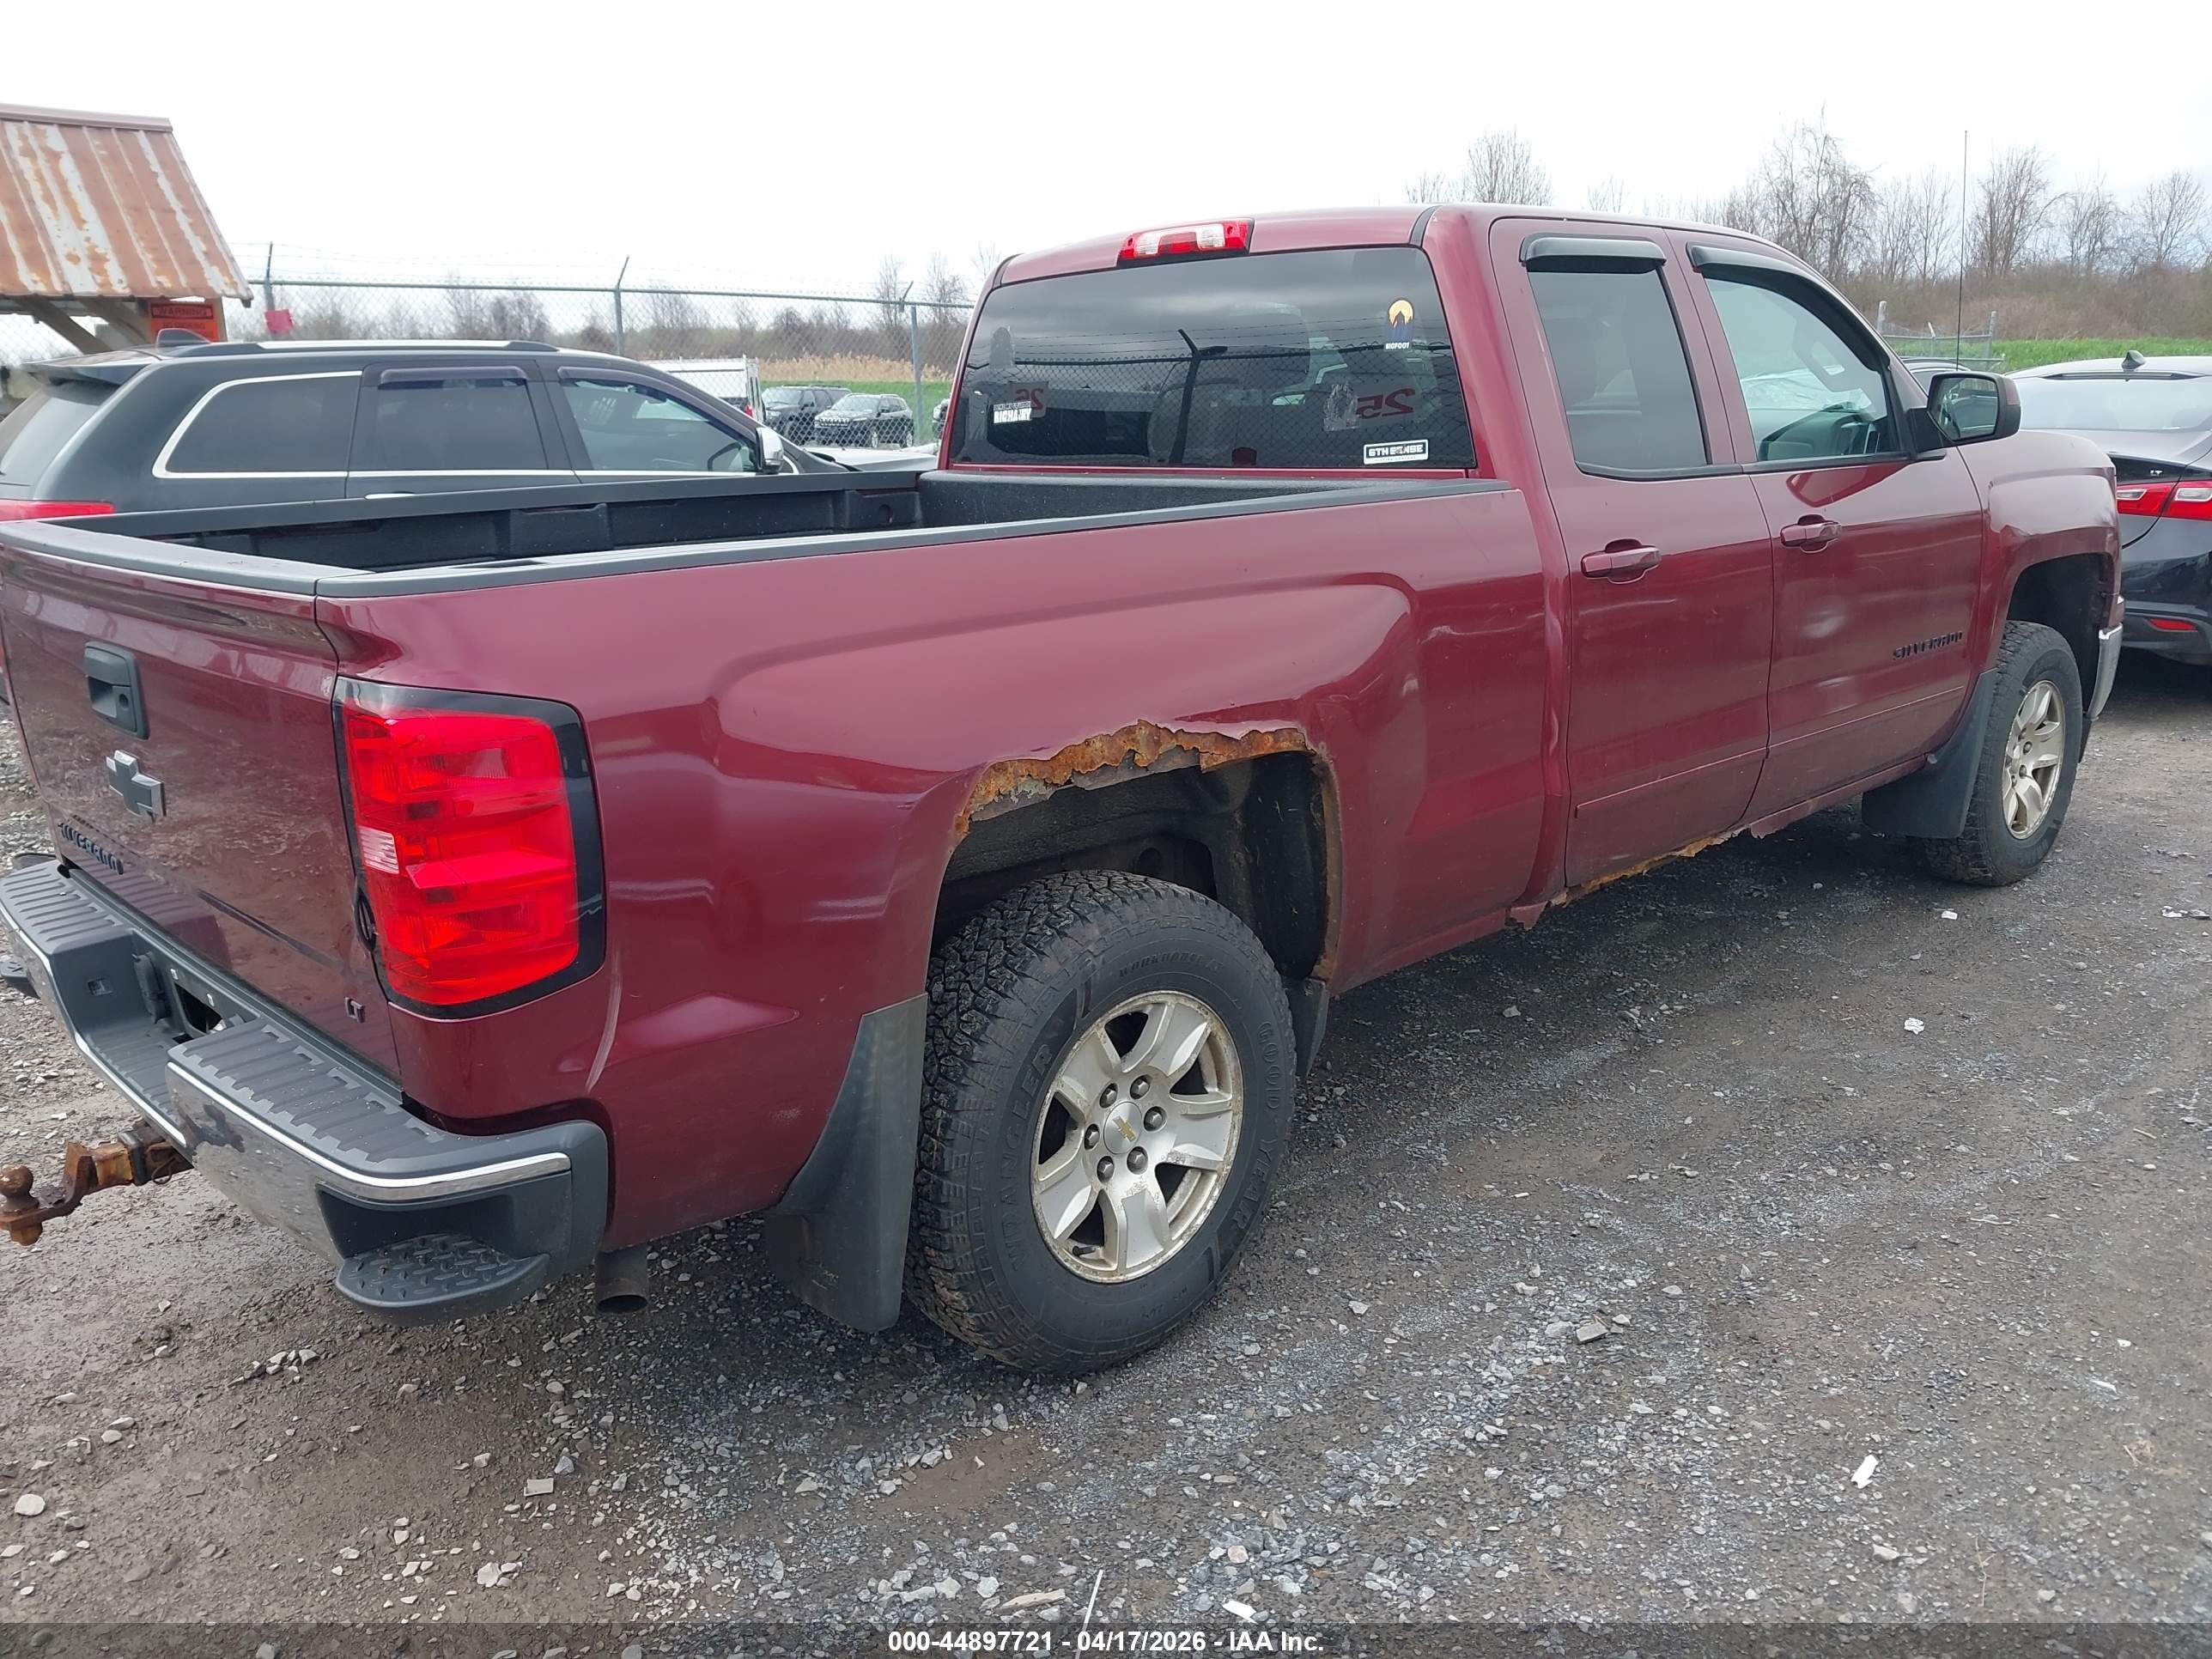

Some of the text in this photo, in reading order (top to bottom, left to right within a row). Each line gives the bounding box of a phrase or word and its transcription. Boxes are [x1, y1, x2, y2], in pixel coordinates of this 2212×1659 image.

[1368, 447, 1389, 457] 6TH
[1893, 631, 1964, 659] SILVERADO
[344, 997, 365, 1023] LT
